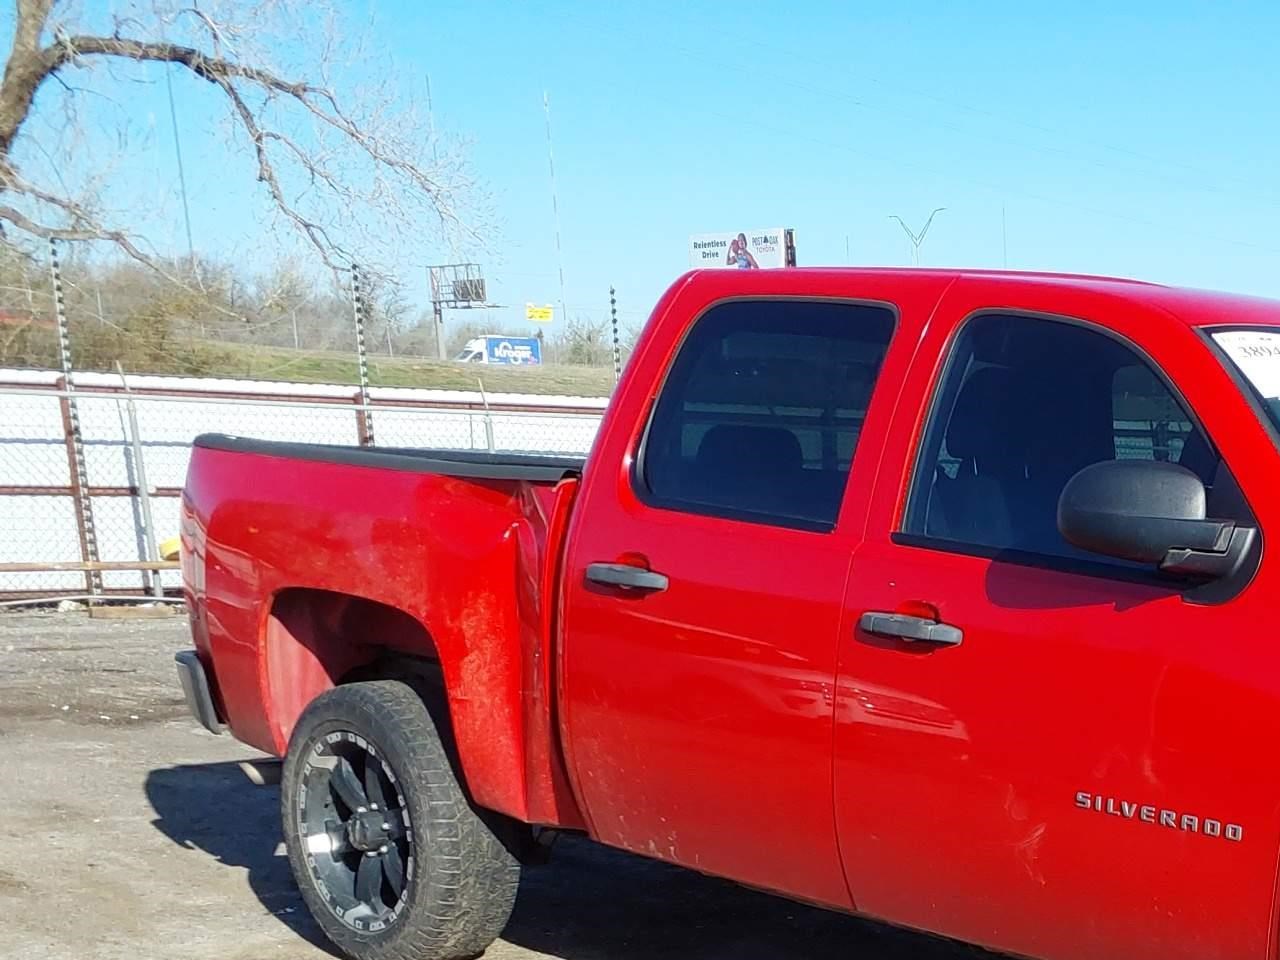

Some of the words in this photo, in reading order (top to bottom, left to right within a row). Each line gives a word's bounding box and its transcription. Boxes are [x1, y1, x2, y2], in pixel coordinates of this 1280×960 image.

[694, 240, 727, 249] Relentless
[702, 251, 719, 259] Drive
[494, 342, 533, 365] Kroger
[1076, 791, 1243, 841] SILVERADO
